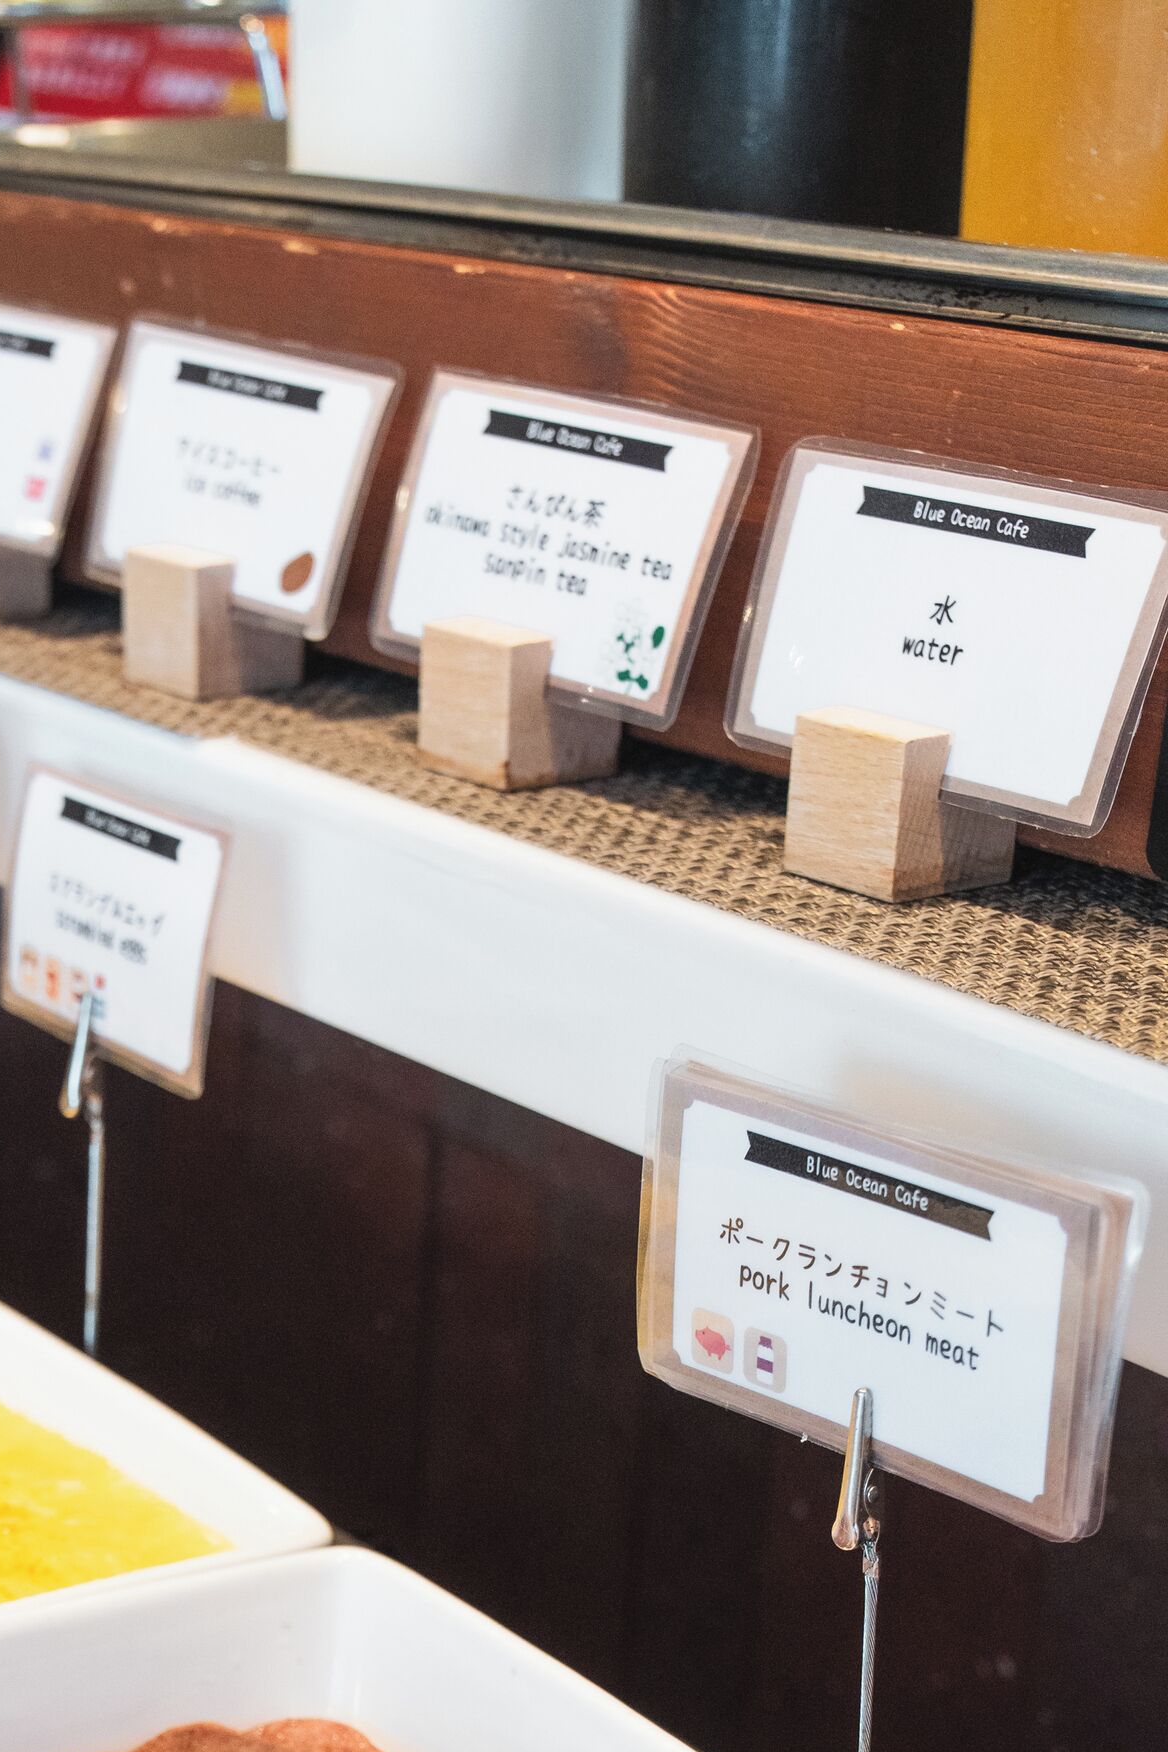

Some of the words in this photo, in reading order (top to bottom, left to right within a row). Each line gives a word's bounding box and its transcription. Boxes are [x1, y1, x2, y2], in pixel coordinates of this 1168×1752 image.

[526, 420, 555, 442] Blue
[556, 427, 592, 450] Ocean
[593, 435, 623, 456] Cafe
[506, 485, 606, 527] さんぴん茶
[913, 500, 945, 523] Blue
[950, 508, 990, 532] Ocean
[996, 517, 1030, 541] Cafe
[500, 523, 550, 552] style
[557, 532, 631, 571] jasmine
[640, 555, 673, 581] tea
[483, 552, 546, 585] sanpin
[556, 570, 588, 596] tea
[929, 595, 957, 625] 水
[901, 635, 964, 666] water
[805, 1155, 839, 1182] Blue
[845, 1168, 888, 1199] Ocean
[894, 1185, 929, 1212] Cafe
[719, 1216, 1004, 1338] ポークランチョンミート
[739, 1264, 790, 1302] pork
[807, 1280, 912, 1346] luncheon
[925, 1331, 980, 1371] meat
